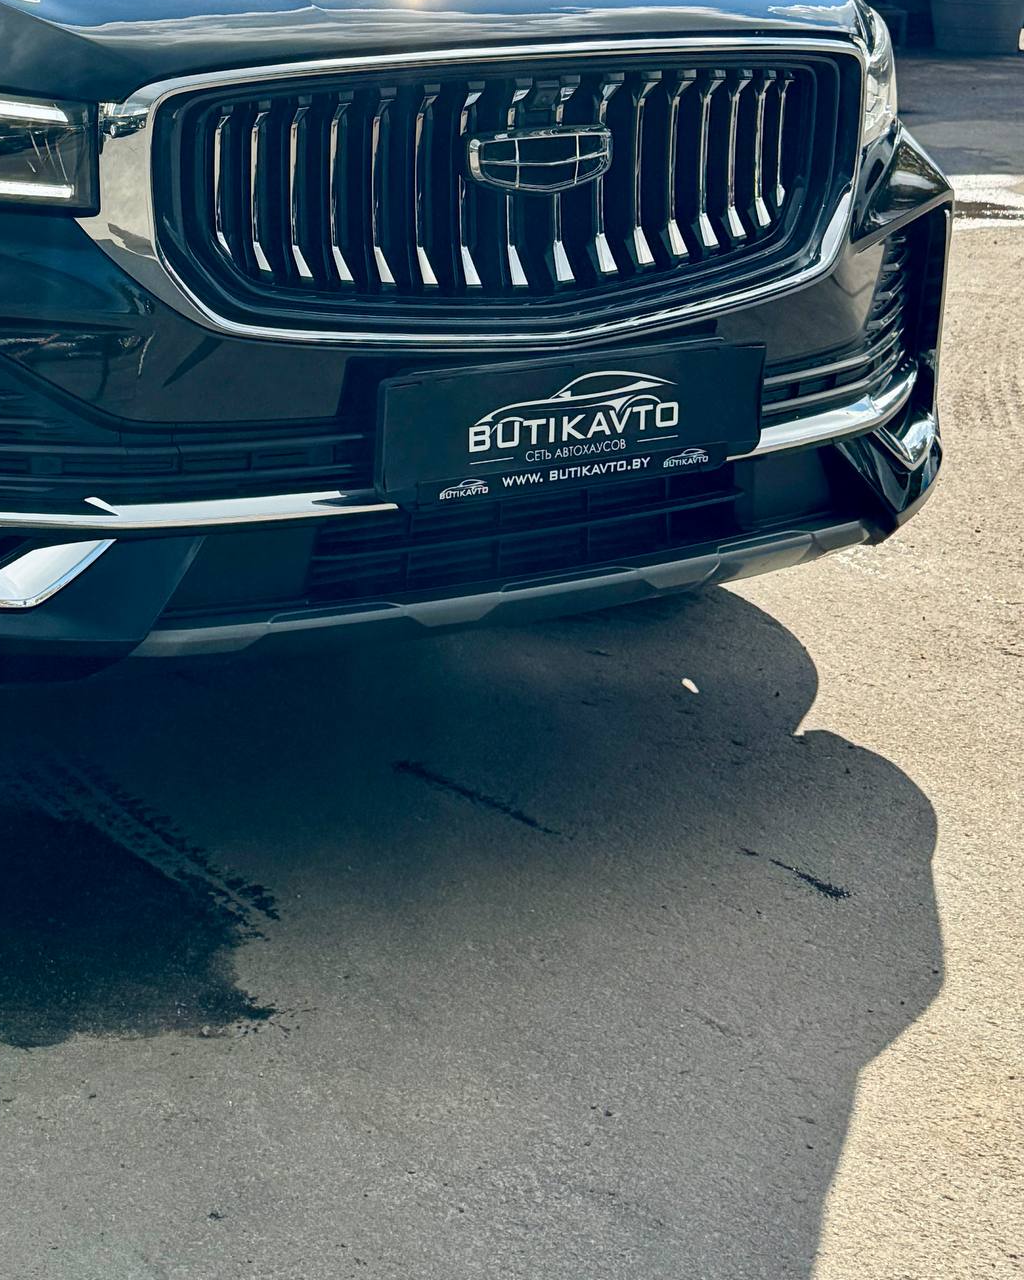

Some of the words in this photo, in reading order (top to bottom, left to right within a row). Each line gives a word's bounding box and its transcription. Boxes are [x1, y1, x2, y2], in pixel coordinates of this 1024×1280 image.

[468, 400, 679, 454] BUTIKAVTO
[525, 449, 553, 463] СЕТЬ
[554, 438, 627, 459] АВТОХАУСОВ
[663, 454, 709, 468] BUTIKAVTO
[439, 485, 489, 500] BUTIKAVTO
